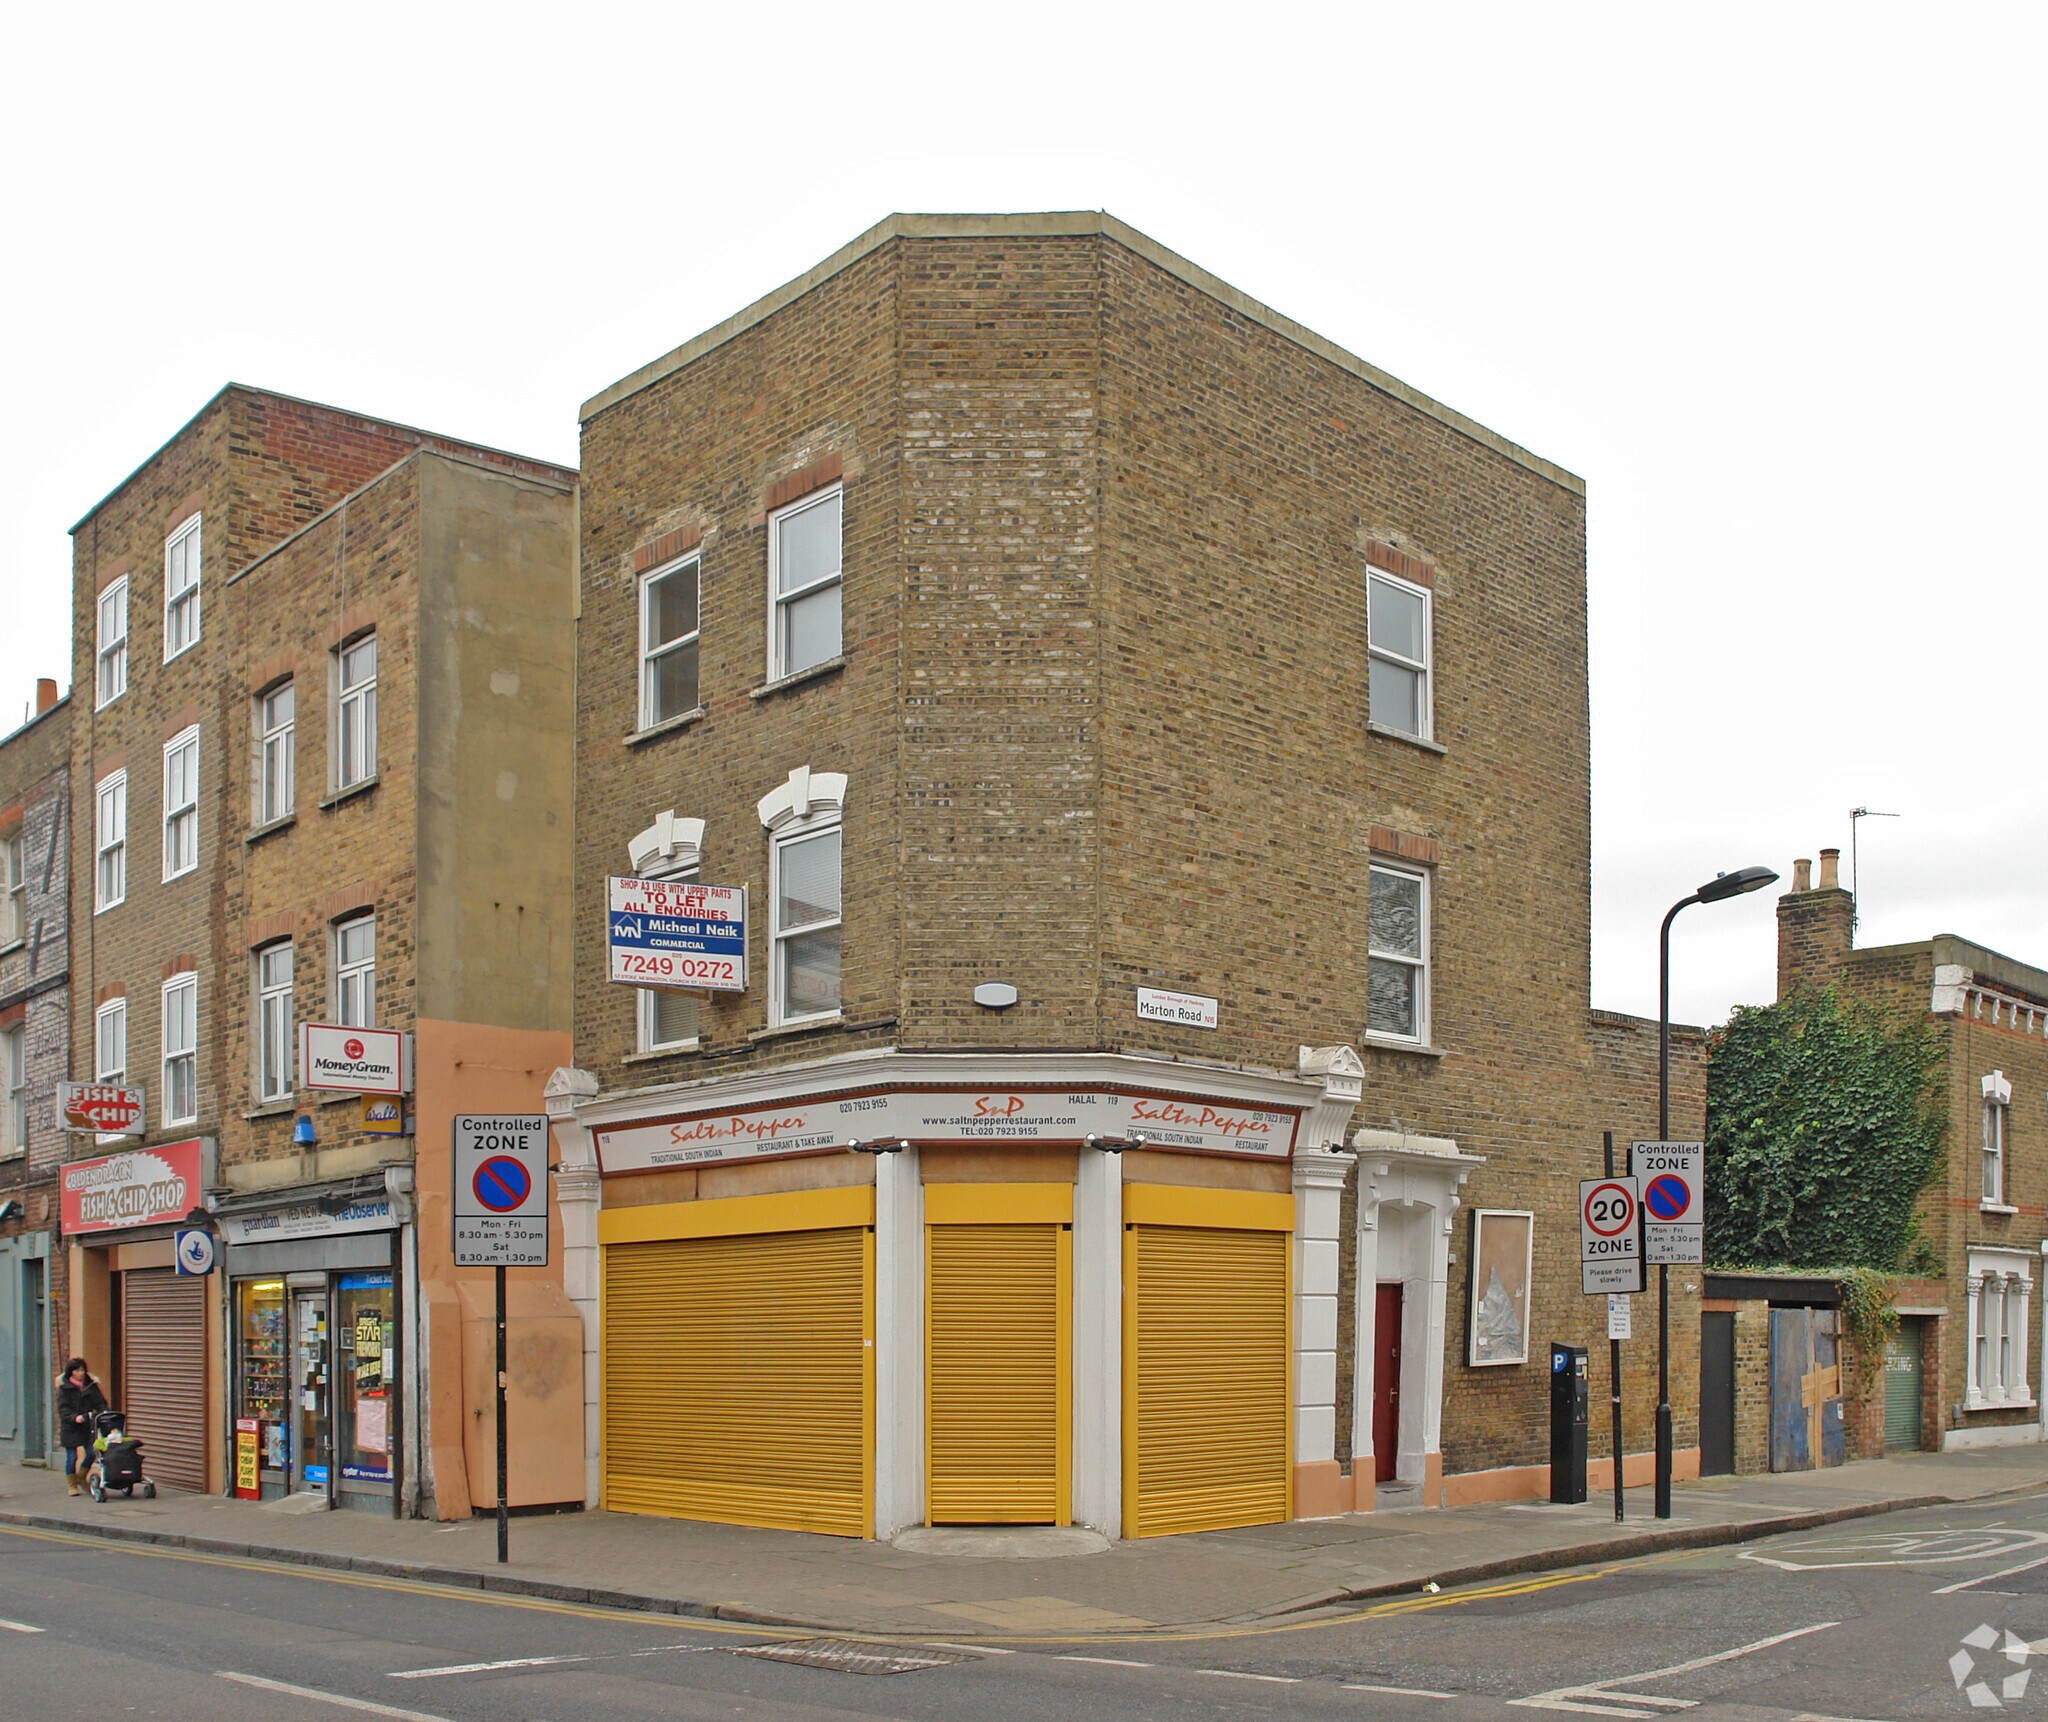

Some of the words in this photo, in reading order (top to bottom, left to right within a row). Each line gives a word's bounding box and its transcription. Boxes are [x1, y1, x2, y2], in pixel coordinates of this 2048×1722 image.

[620, 879, 638, 890] SHOP
[641, 880, 650, 891] A3
[652, 882, 666, 892] USE
[668, 884, 684, 895] WITH
[687, 886, 708, 897] UPPER
[711, 888, 732, 899] PARTS
[644, 891, 667, 904] TO
[676, 894, 706, 908] LET
[623, 902, 648, 913] ALL
[655, 905, 728, 921] ENQUIRIES
[648, 919, 700, 934] Michael
[706, 924, 738, 938] Naik
[650, 938, 705, 950] COMMERCIAL
[621, 954, 673, 975] 7249
[682, 959, 734, 980] 0272
[1140, 1001, 1175, 1018] Marton
[1178, 1007, 1202, 1022] Road
[314, 1058, 391, 1074] MoneyGram
[71, 1087, 119, 1103] FISH
[123, 1089, 139, 1103] &
[1068, 1095, 1097, 1104] HALAL
[1108, 1096, 1118, 1105] 119
[839, 1103, 852, 1113] 020
[854, 1100, 871, 1112] 7923
[872, 1098, 888, 1109] 9155
[88, 1107, 141, 1122] CHIP
[922, 1116, 1076, 1127] www.saltnpepperrestaurant.com
[1252, 1112, 1264, 1122] 020
[1264, 1113, 1278, 1123] 7923
[1279, 1115, 1292, 1124] 9155
[462, 1119, 541, 1131] Controlled
[996, 1127, 1016, 1136] 7923
[1018, 1127, 1038, 1136] 9155
[473, 1135, 529, 1150] ZONE
[756, 1140, 794, 1152] RESTAURANT
[800, 1137, 816, 1147] TAKE
[816, 1135, 834, 1145] AWAY
[1164, 1133, 1183, 1143] SOUTH
[1184, 1135, 1204, 1145] INDIAN
[1234, 1140, 1269, 1151] RESTAURANT
[650, 1152, 684, 1164] TRADITIONAL
[685, 1150, 703, 1160] SOUTH
[704, 1148, 723, 1158] INDIAN
[1637, 1144, 1699, 1154] Controlled
[1646, 1158, 1689, 1169] ZONE
[80, 1193, 105, 1220] FISH
[106, 1192, 116, 1217] &
[117, 1185, 146, 1214] CHIP
[149, 1181, 184, 1210] SHOP
[1593, 1199, 1627, 1222] 20
[242, 1212, 280, 1236] guardian
[481, 1220, 501, 1228] Mon
[509, 1220, 521, 1228] Fri
[459, 1231, 481, 1239] 8.30
[505, 1231, 527, 1239] 5.30
[529, 1233, 543, 1241] pm
[493, 1243, 509, 1251] Sat
[1588, 1239, 1633, 1254] ZONE
[460, 1253, 483, 1262] 8.30
[505, 1253, 525, 1262] 1.30
[527, 1255, 542, 1263] pm
[1614, 1267, 1632, 1275] drive
[1600, 1276, 1622, 1284] slowly
[356, 1325, 381, 1341] STAR
[1554, 1354, 1564, 1369] P
